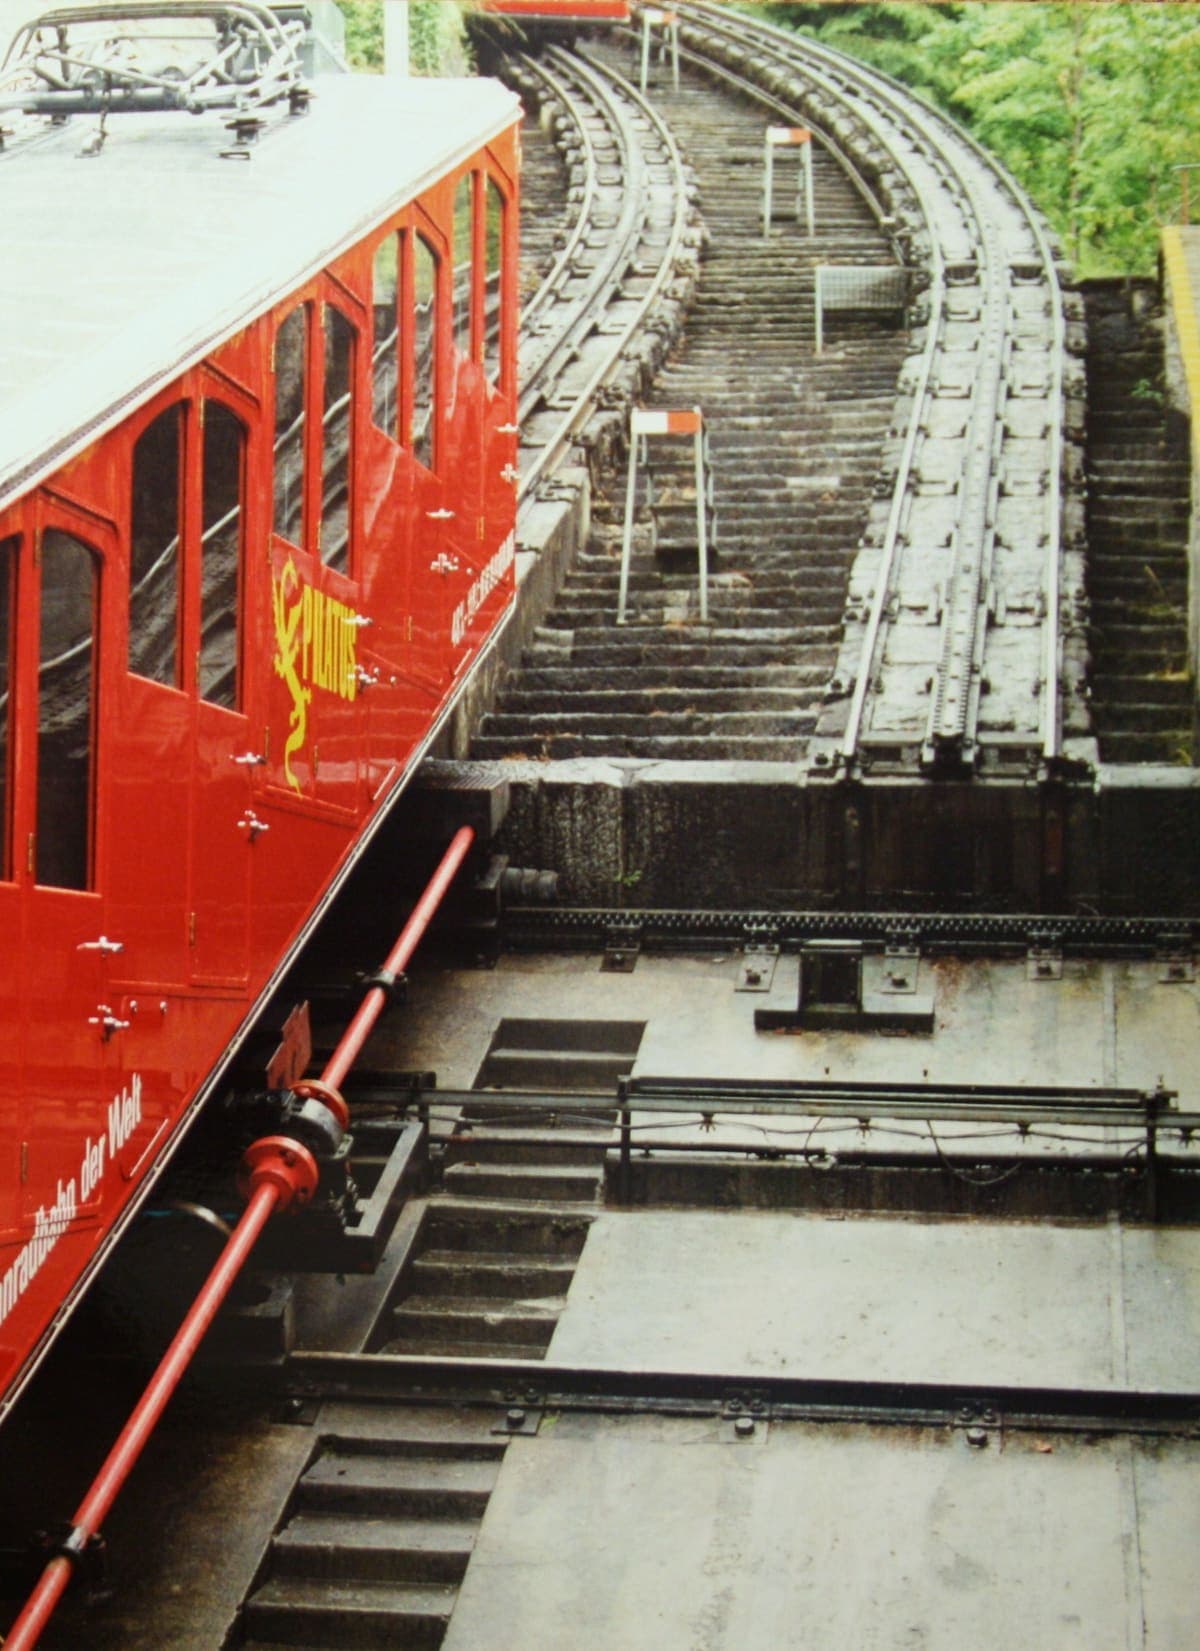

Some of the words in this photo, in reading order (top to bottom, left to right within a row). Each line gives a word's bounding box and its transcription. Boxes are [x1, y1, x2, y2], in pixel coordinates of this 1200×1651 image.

[303, 585, 357, 702] PILATUS
[81, 1134, 106, 1203] der
[108, 1072, 142, 1160] Welt
